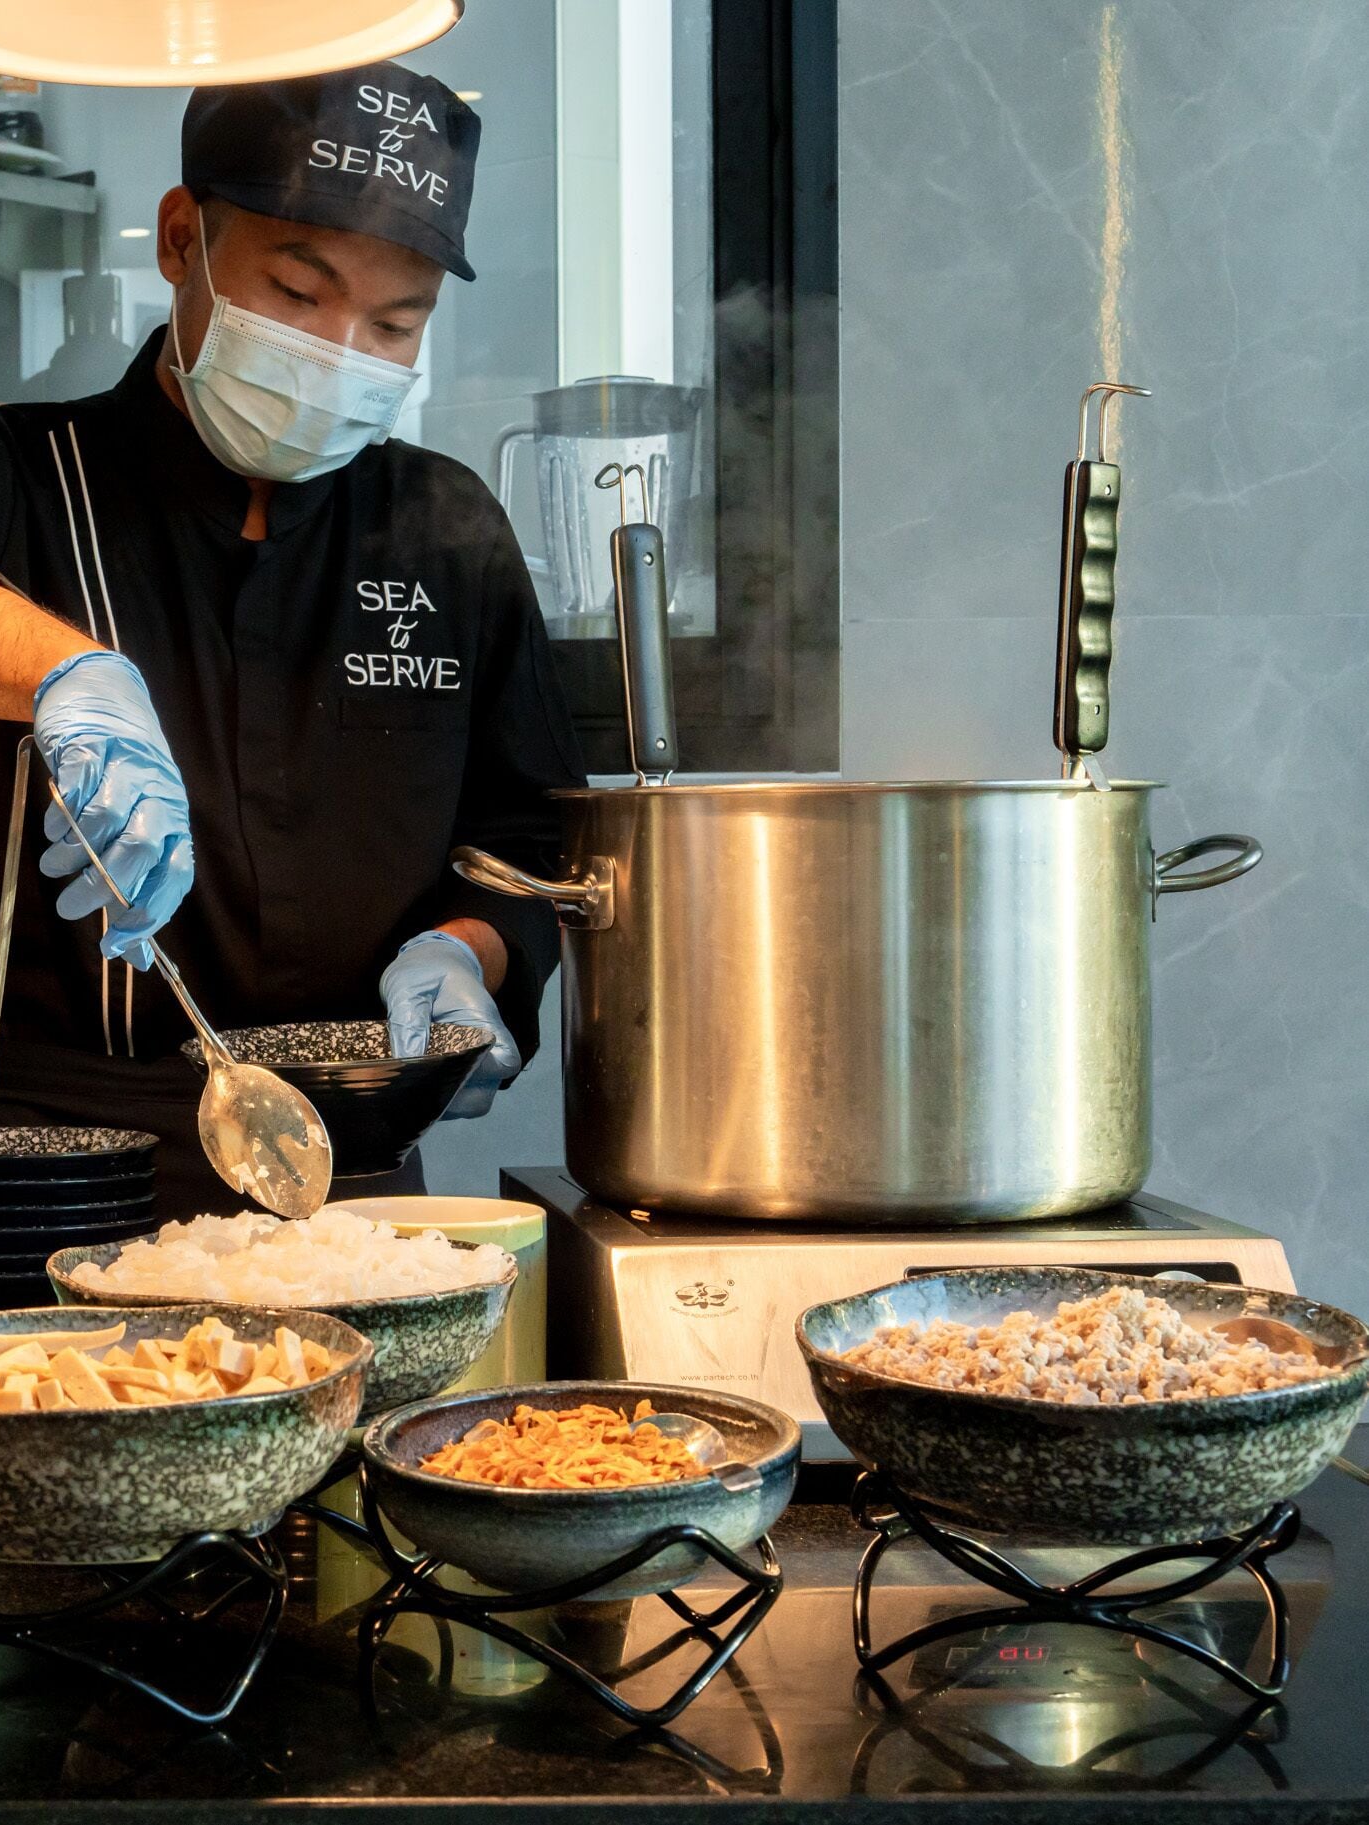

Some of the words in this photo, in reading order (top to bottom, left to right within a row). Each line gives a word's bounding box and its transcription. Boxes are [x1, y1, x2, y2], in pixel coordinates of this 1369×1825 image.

[357, 85, 439, 133] SEA
[379, 124, 415, 153] to
[308, 139, 448, 207] SERVE
[356, 581, 437, 612] SEA
[387, 614, 418, 649] to
[344, 653, 461, 690] SERVE
